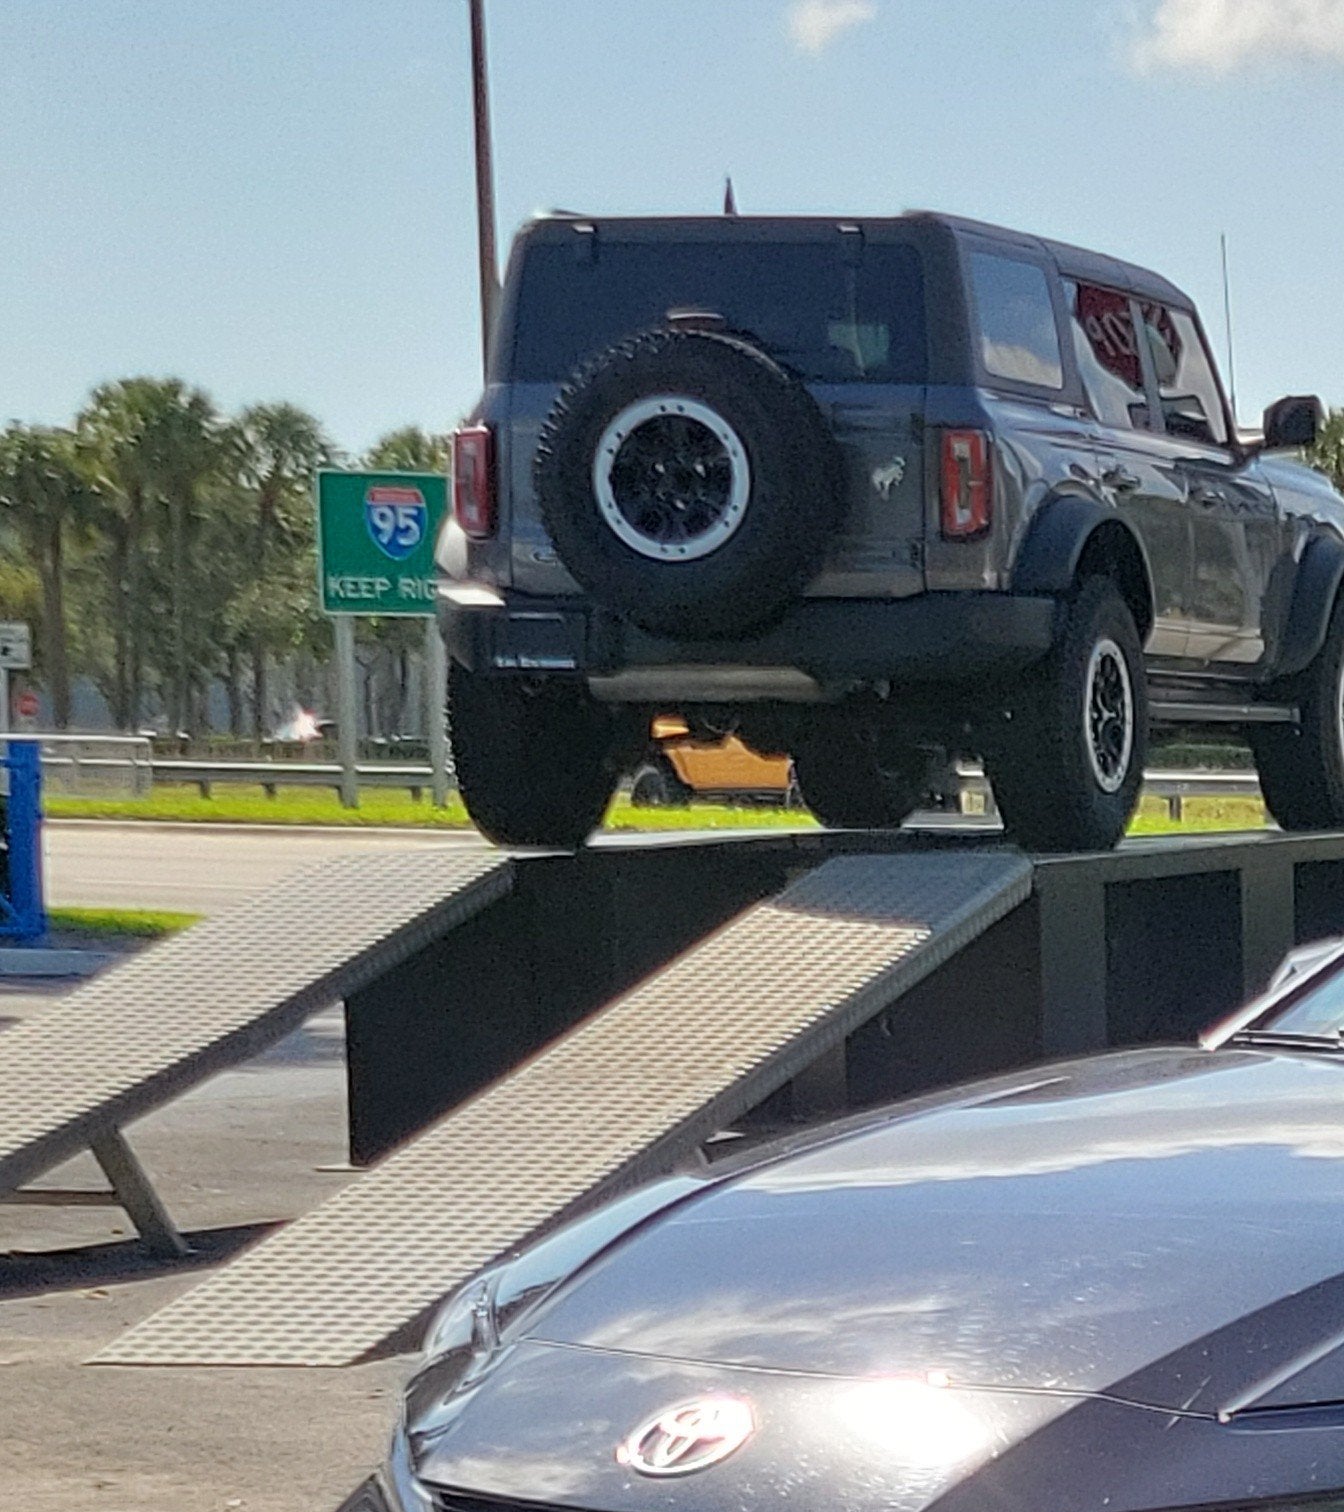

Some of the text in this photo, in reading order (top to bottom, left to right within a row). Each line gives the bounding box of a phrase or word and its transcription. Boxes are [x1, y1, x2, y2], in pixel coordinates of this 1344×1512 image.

[371, 504, 420, 547] 95
[327, 576, 438, 600] KEEP RIG
